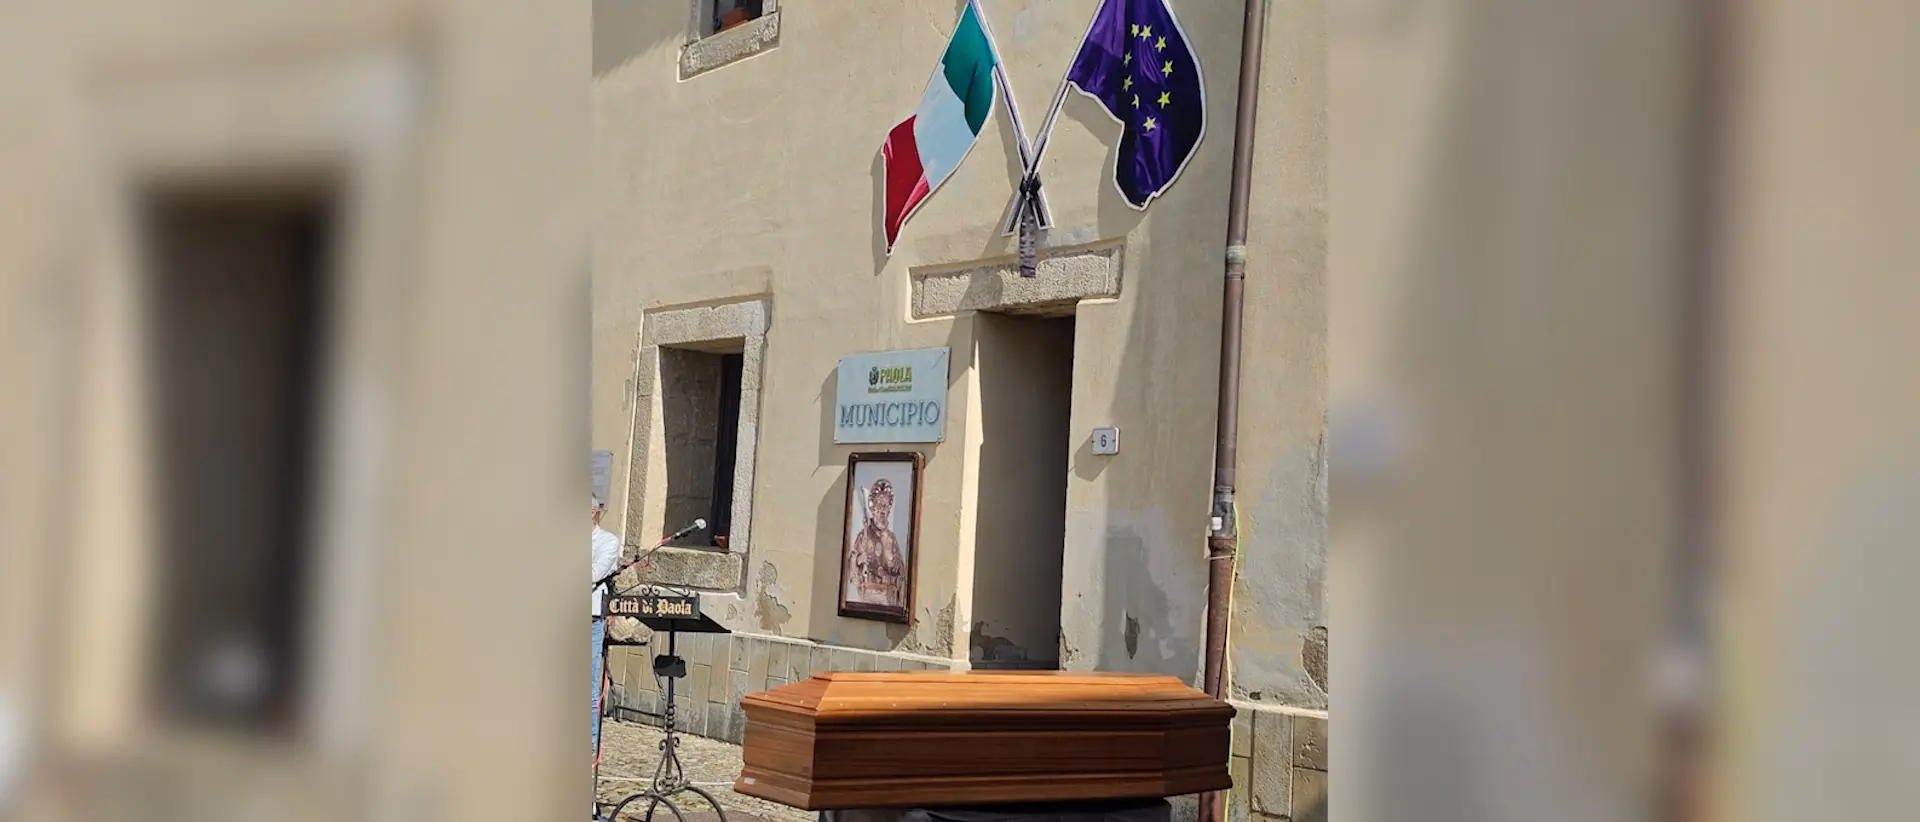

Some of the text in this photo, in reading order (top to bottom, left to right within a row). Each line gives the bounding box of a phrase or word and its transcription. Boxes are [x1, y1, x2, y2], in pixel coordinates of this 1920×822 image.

[880, 366, 912, 384] PAOLA
[840, 400, 940, 427] MUNICIPIO
[1100, 434, 1107, 448] 6
[609, 598, 692, 617] Città di Paola
